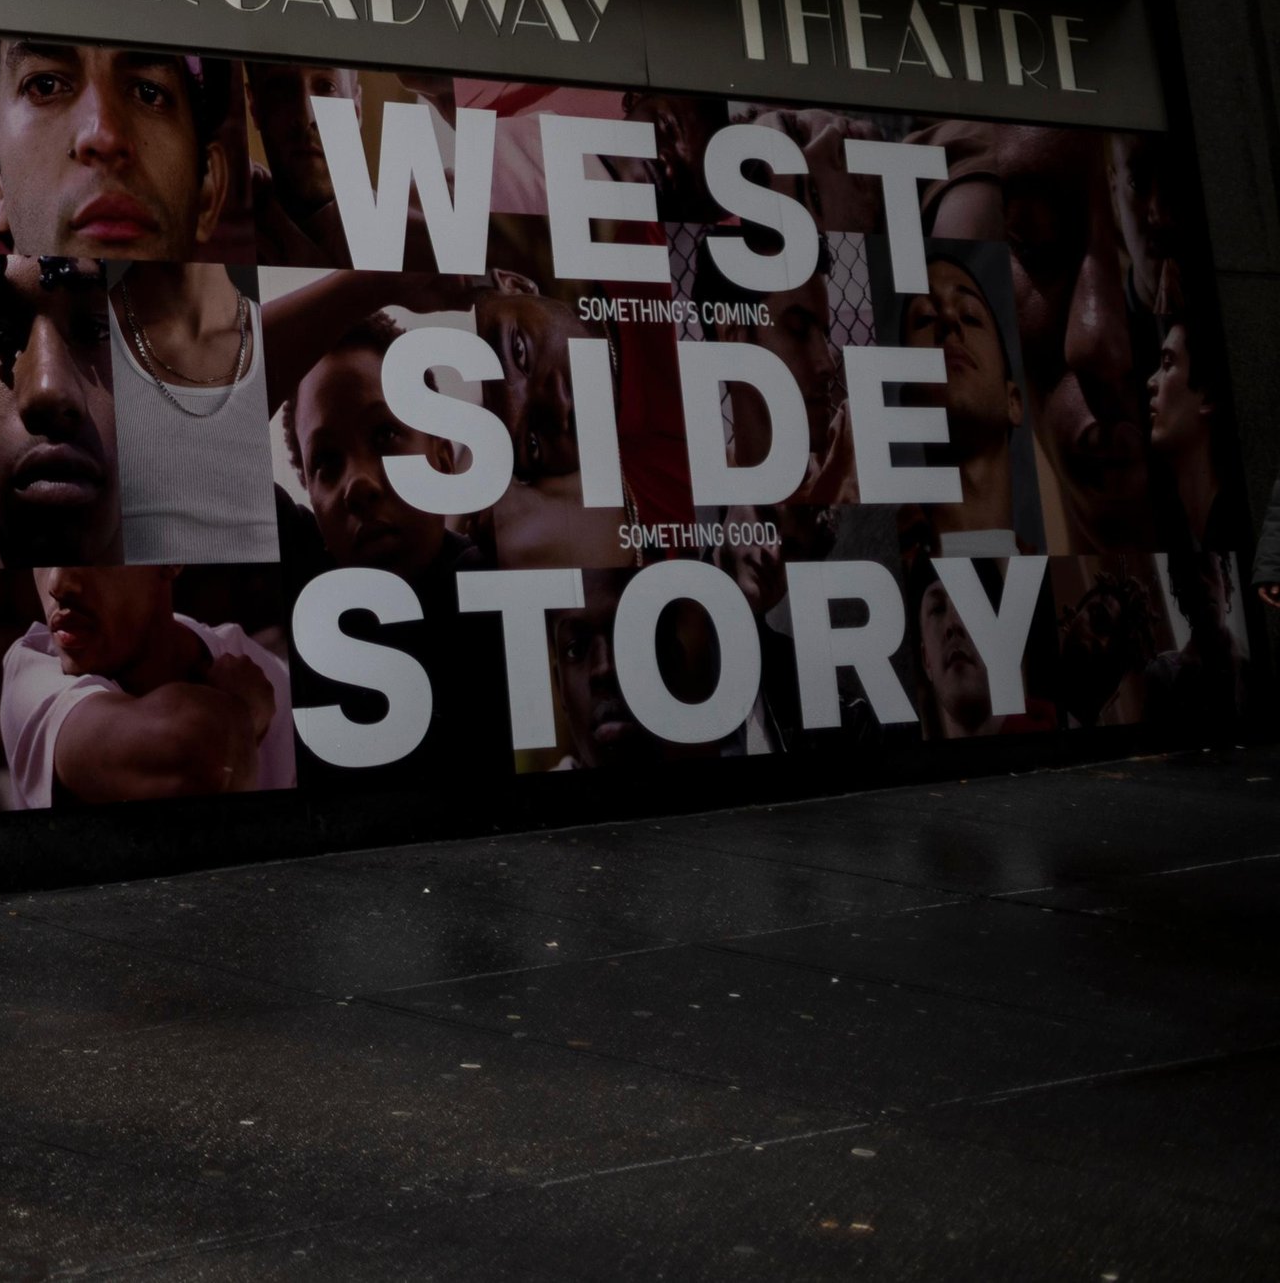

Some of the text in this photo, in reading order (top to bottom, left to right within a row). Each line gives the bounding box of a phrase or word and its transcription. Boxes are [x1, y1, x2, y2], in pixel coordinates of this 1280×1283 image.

[312, 95, 947, 294] WEST
[702, 299, 774, 327] COMING.
[381, 325, 962, 515] SIDE
[618, 520, 782, 550] SOMETHING GOOD.
[293, 556, 1050, 770] STORY
